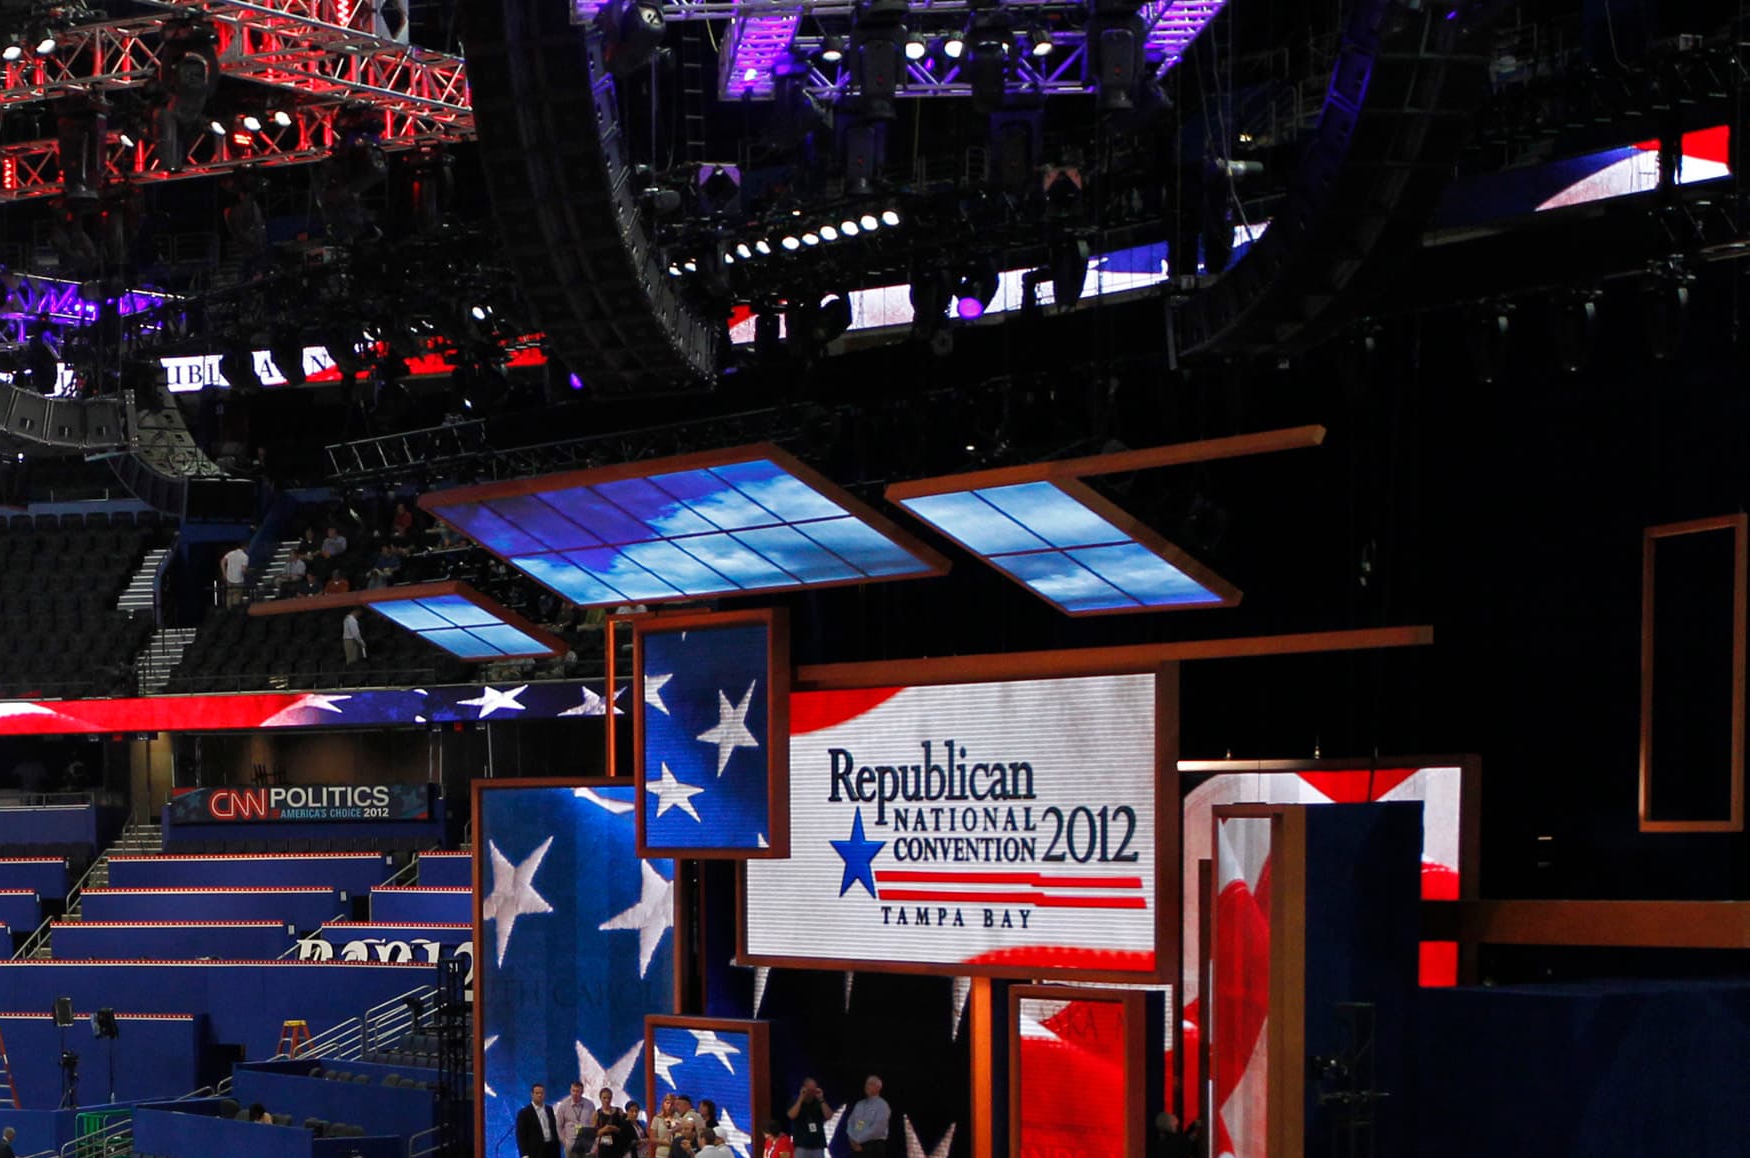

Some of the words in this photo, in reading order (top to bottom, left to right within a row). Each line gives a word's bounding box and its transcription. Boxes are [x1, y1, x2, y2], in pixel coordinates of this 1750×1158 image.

[827, 739, 1037, 825] Republican
[209, 789, 268, 819] CNN
[270, 786, 390, 808] POLITICS
[280, 808, 327, 818] AMERICA'S
[330, 808, 361, 818] CHOICE
[363, 807, 389, 818] 2012
[893, 806, 1037, 832] NATIONAL
[1041, 805, 1139, 863] 2012
[893, 837, 1037, 862] CONVENTION
[881, 906, 964, 927] TAMPA
[983, 908, 1031, 929] BAY
